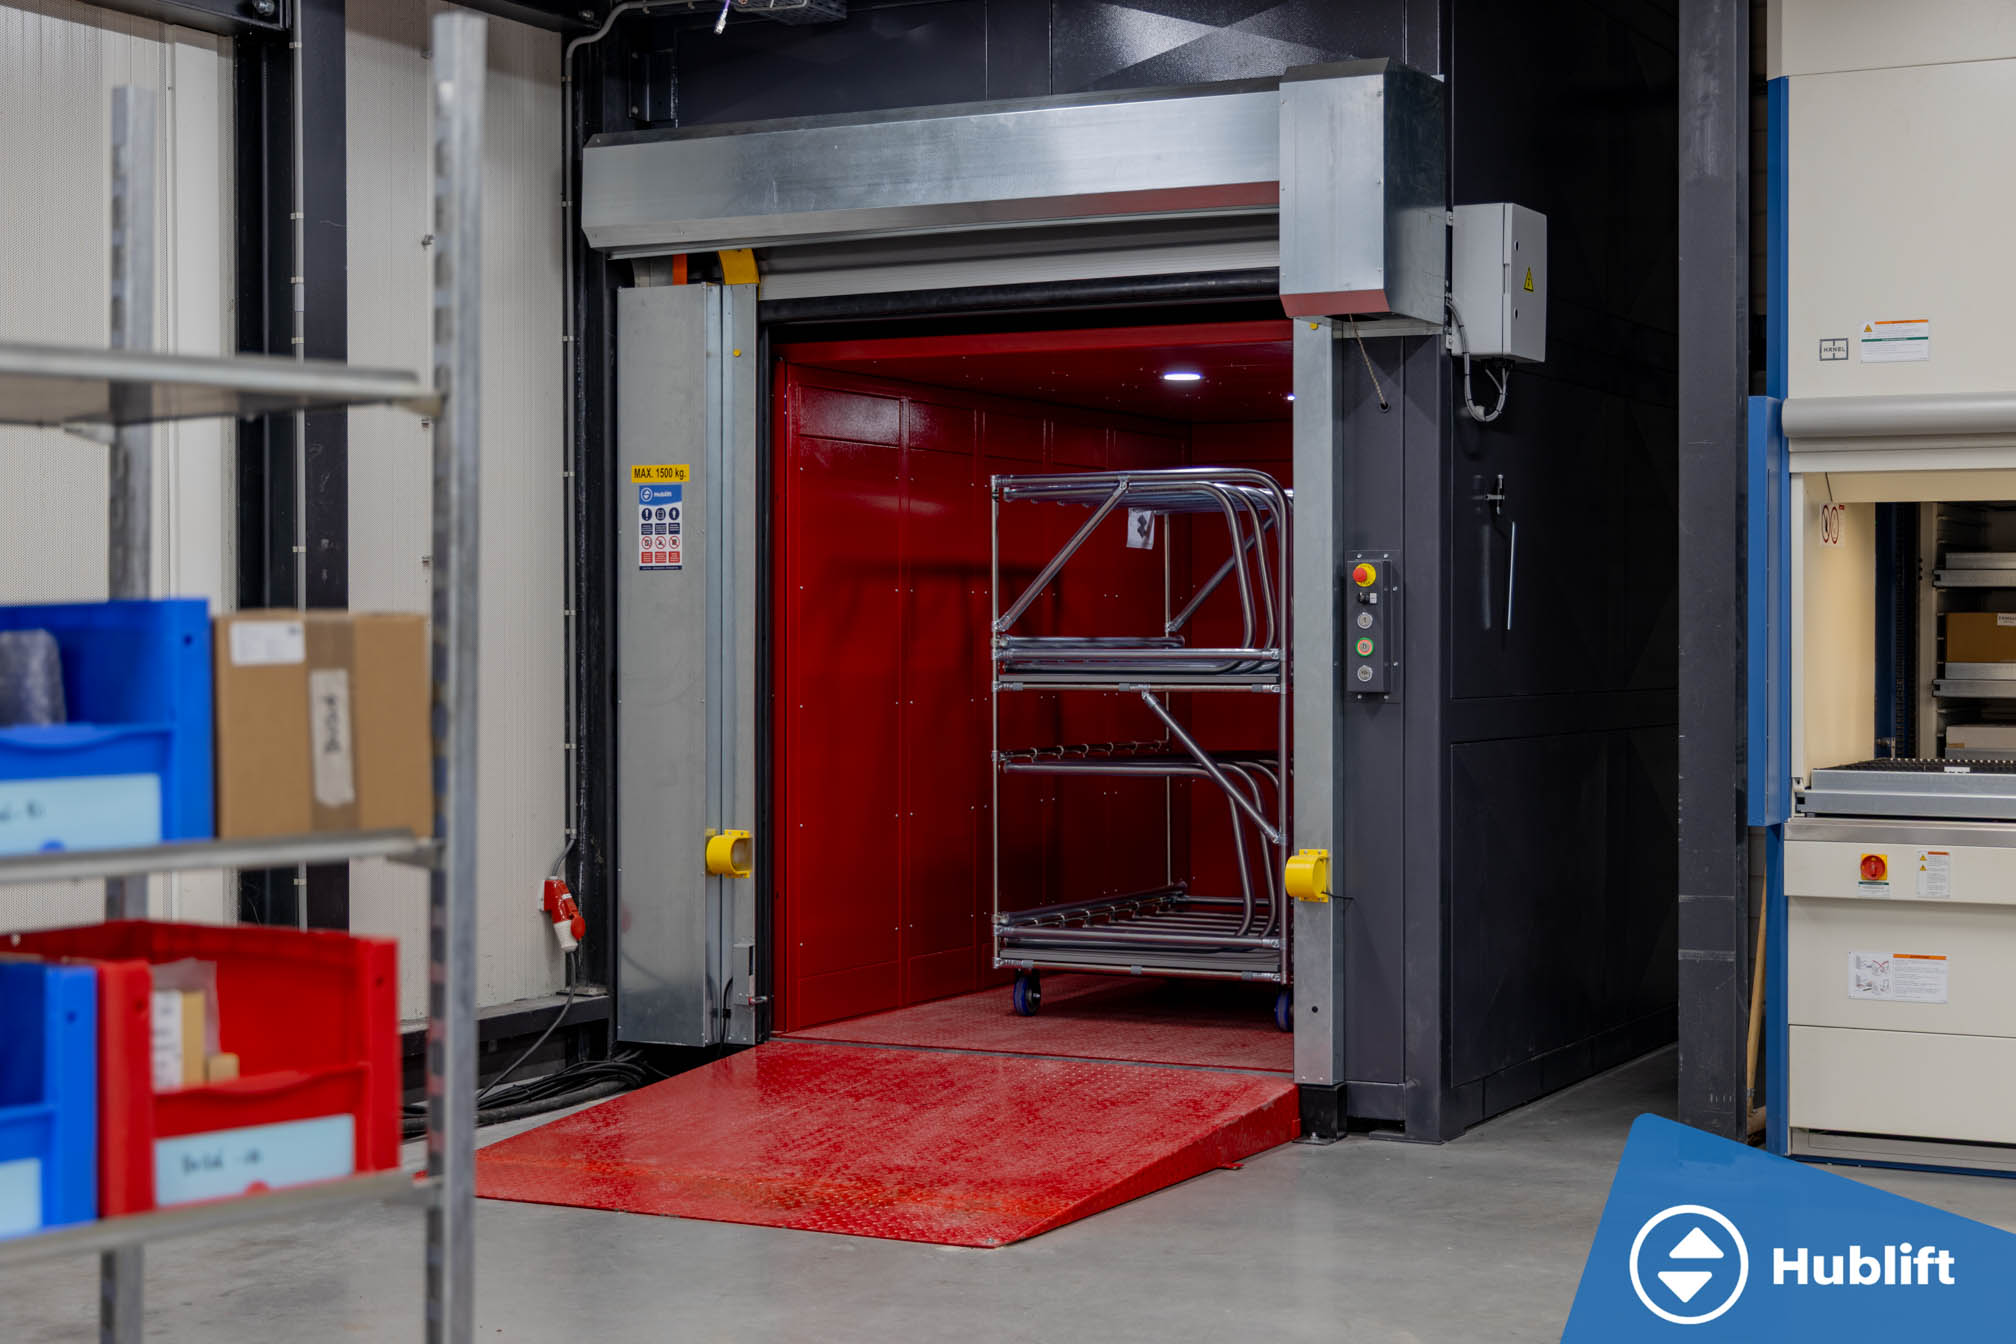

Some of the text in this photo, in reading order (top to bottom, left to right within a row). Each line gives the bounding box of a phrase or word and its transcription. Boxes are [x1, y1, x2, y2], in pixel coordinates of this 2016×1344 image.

[634, 467, 686, 480] MAX. 1500 kg.
